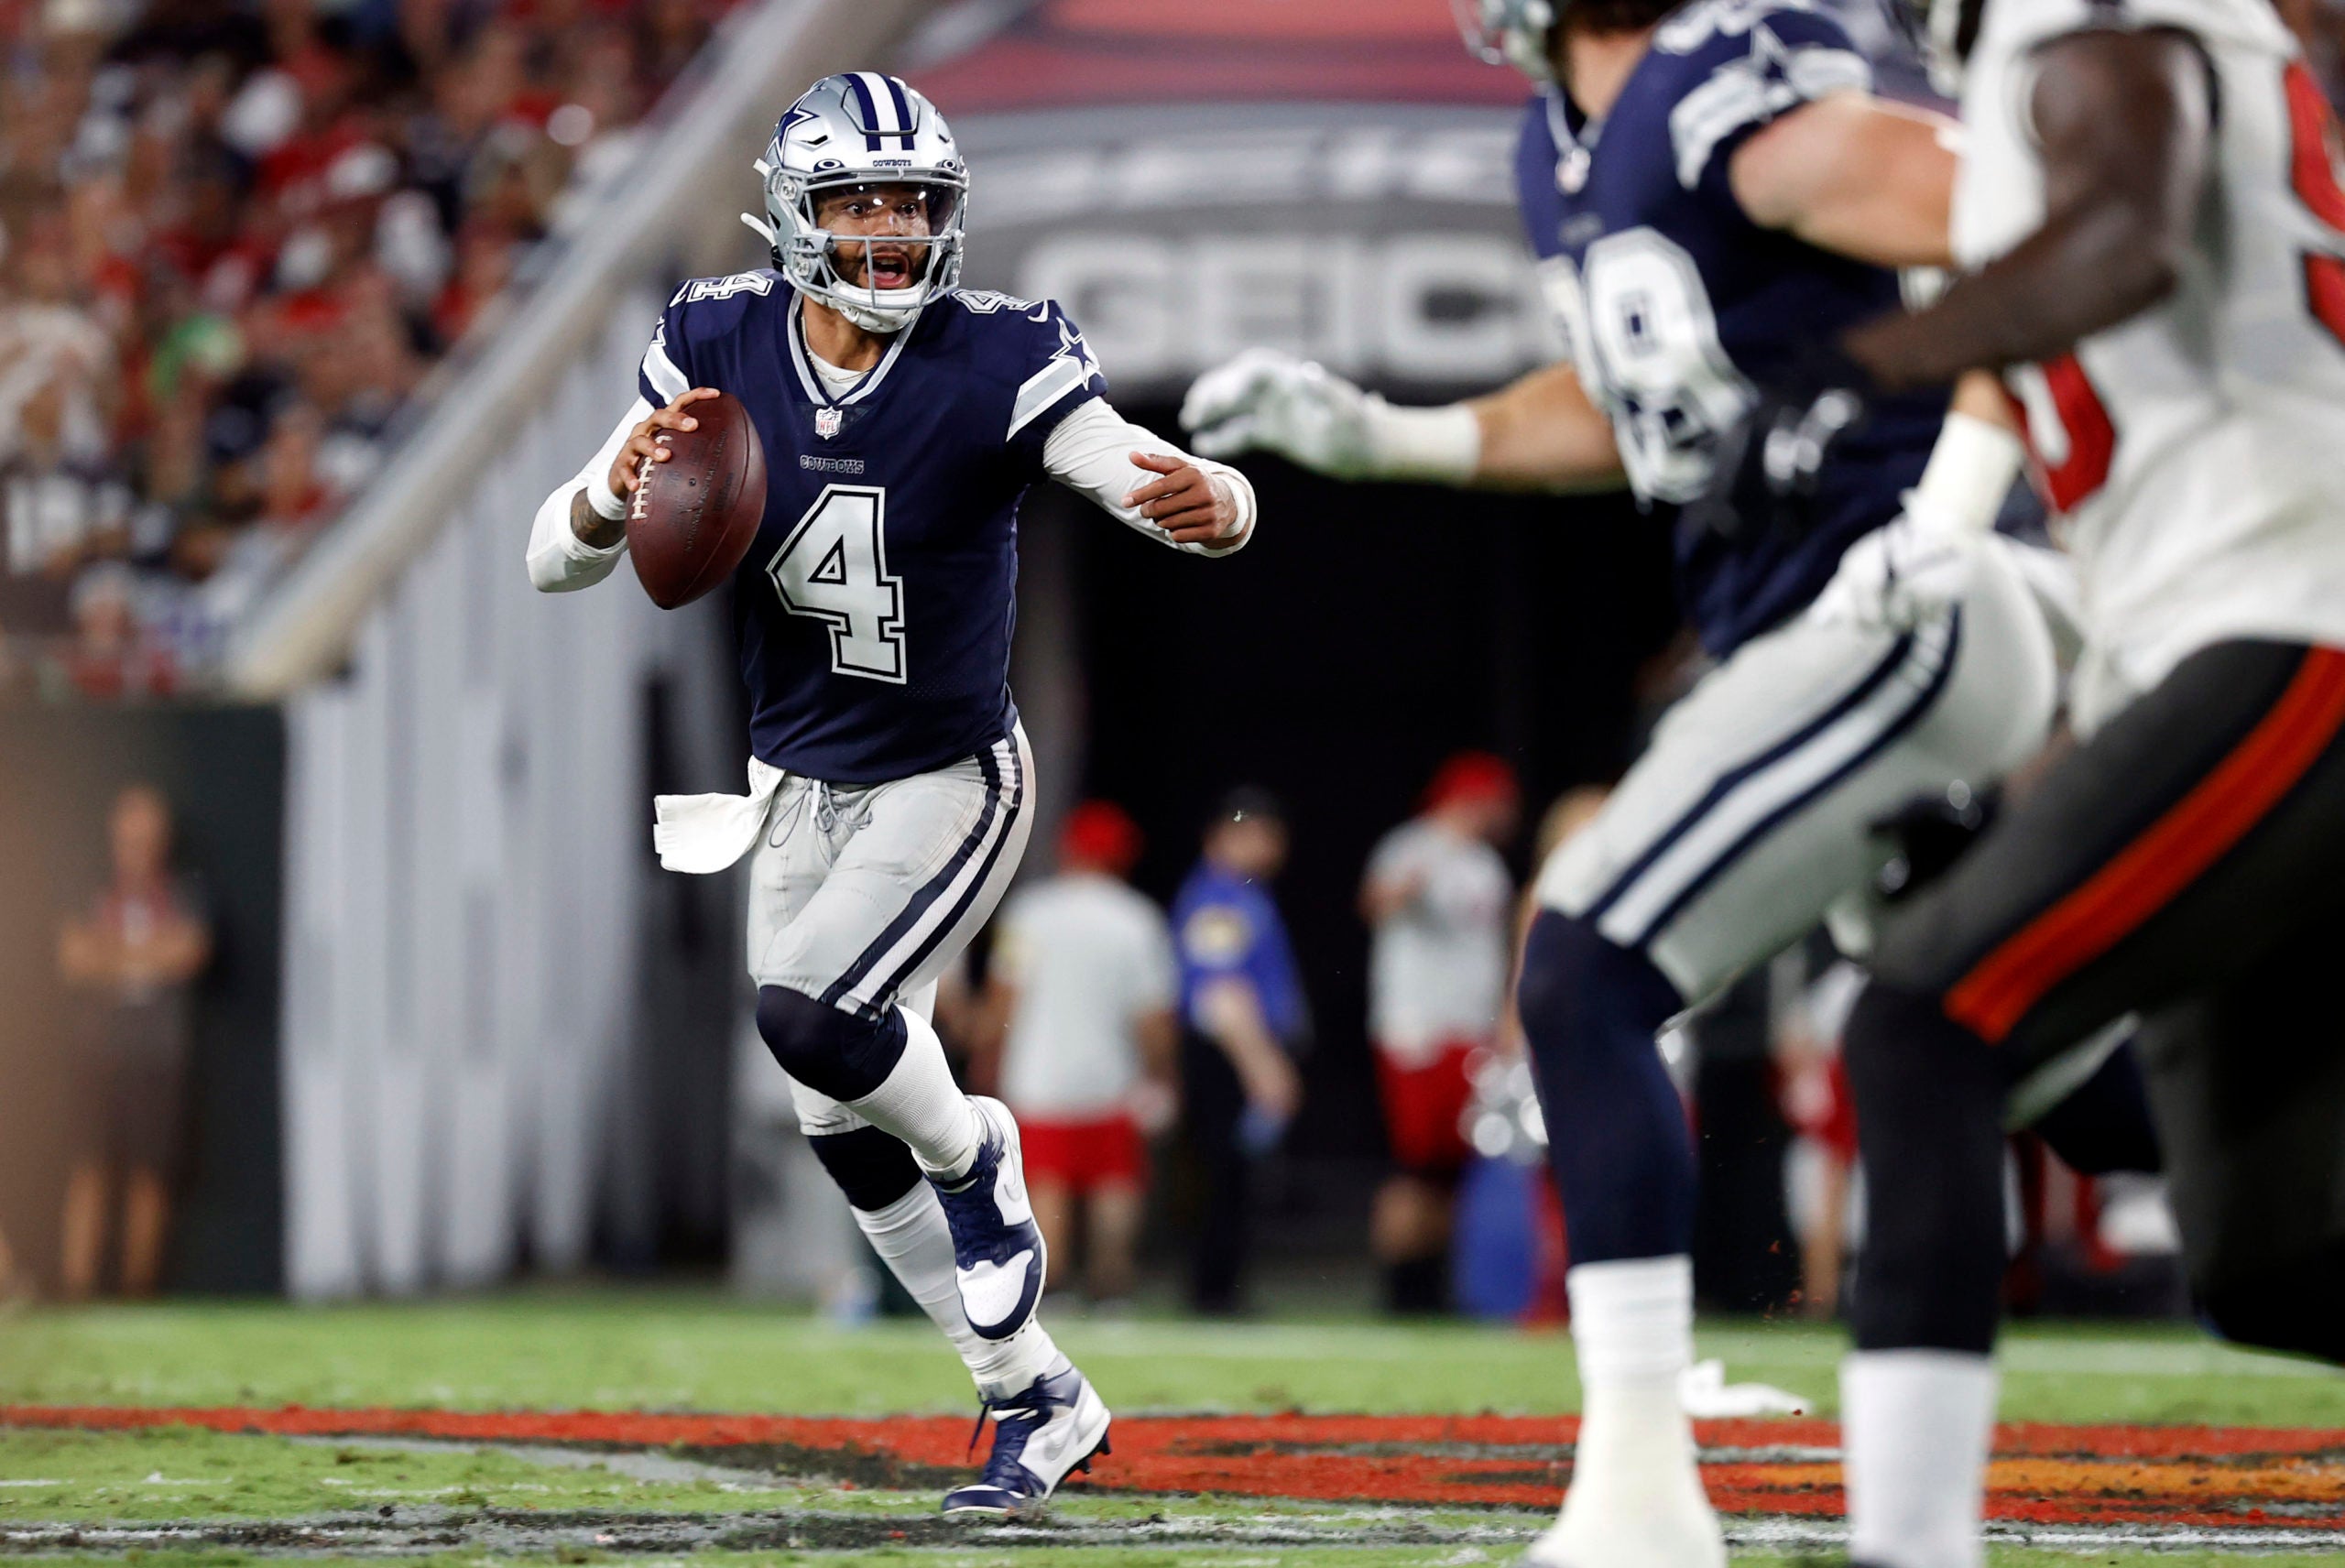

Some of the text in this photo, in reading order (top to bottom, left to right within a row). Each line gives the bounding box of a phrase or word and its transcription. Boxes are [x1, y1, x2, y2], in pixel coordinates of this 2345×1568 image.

[872, 158, 911, 168] COWBOYS
[686, 271, 774, 303] 4
[1017, 231, 1548, 383] GEIC
[800, 454, 865, 475] COWBOYS
[765, 483, 908, 685] 4
